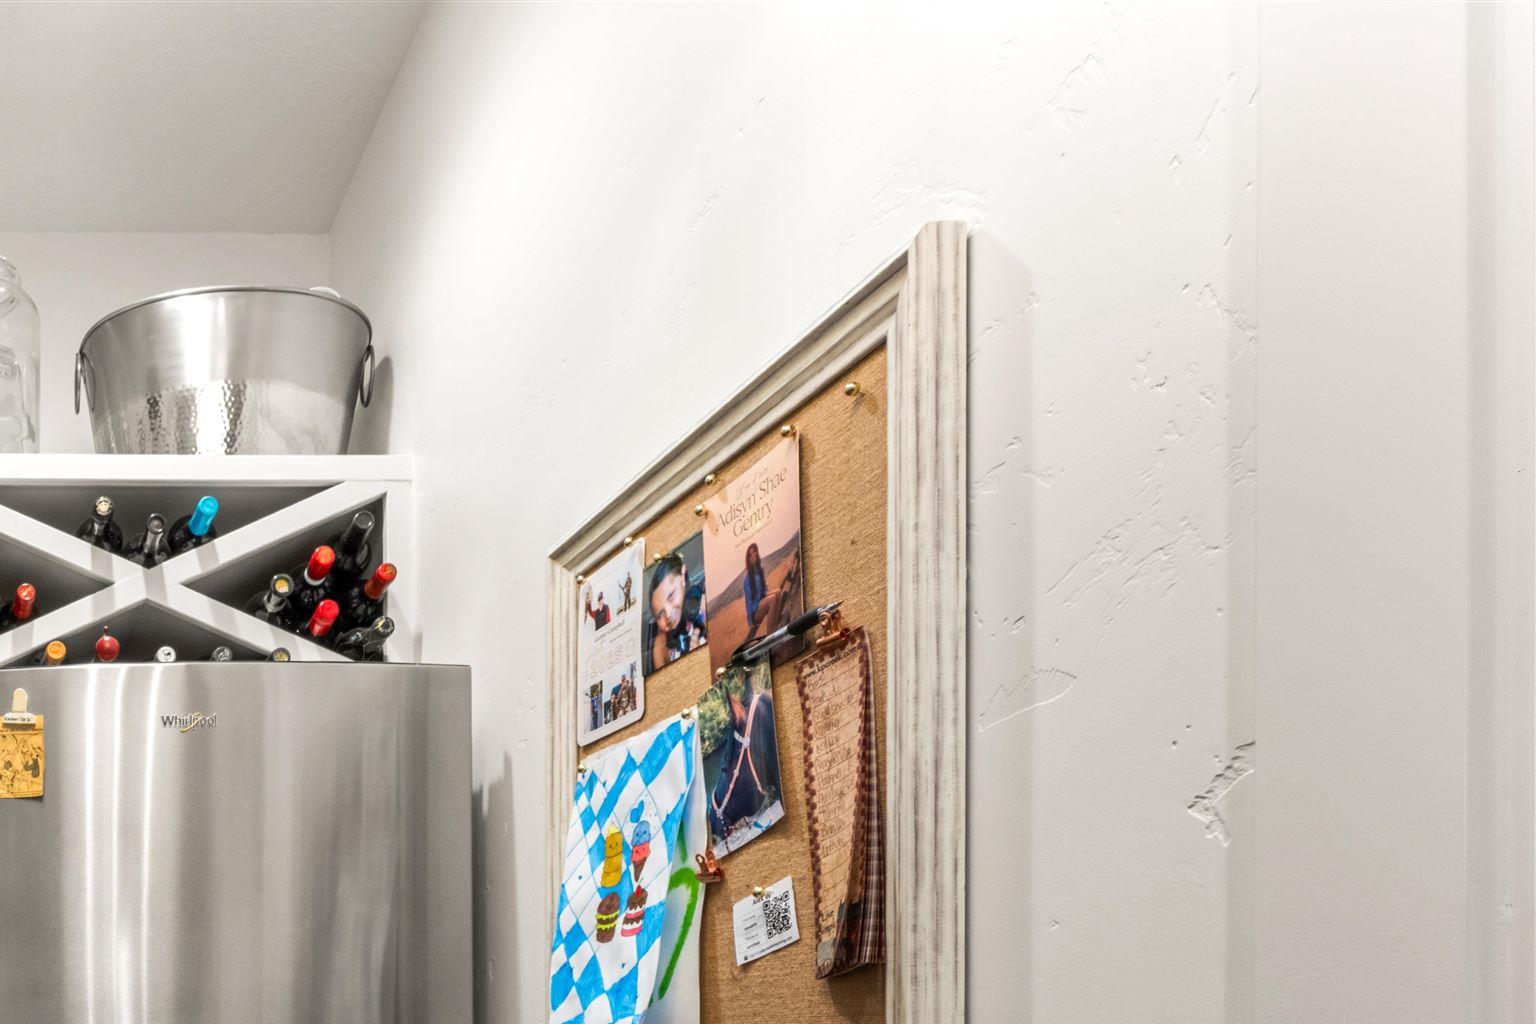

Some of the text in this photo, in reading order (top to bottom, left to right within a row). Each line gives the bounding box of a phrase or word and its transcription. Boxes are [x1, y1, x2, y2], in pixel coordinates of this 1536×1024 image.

[718, 493, 757, 527] Adisyn
[759, 467, 787, 500] Shae
[732, 500, 774, 537] Gentry
[161, 712, 217, 733] Whirlpool
